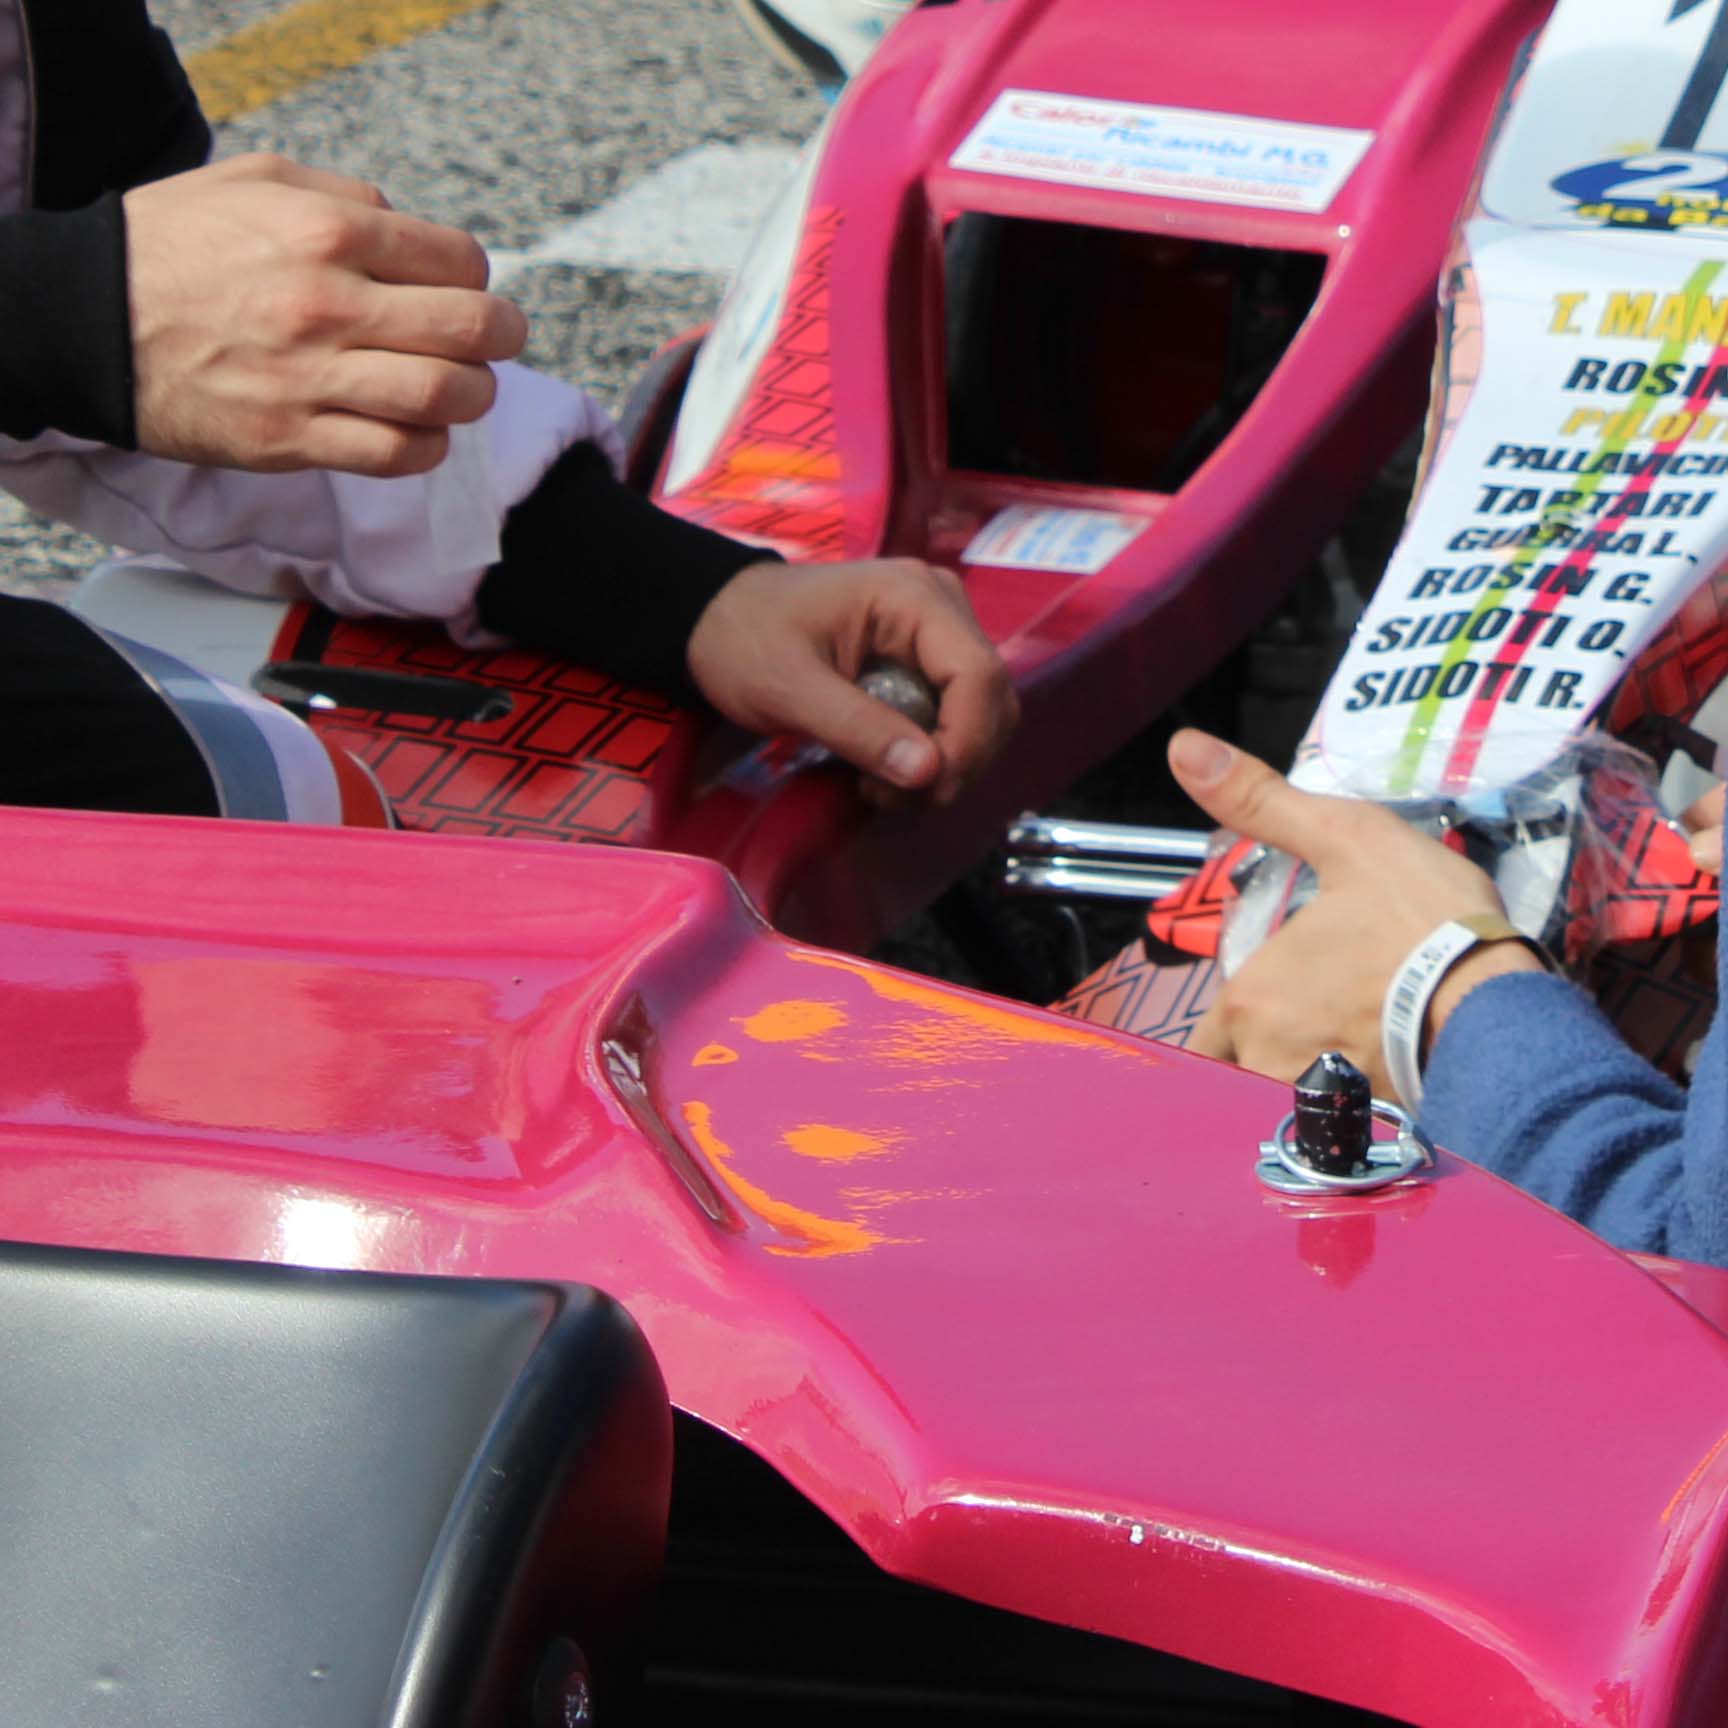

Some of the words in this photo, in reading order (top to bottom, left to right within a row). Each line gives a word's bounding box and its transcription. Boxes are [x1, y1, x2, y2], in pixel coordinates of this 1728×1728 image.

[1576, 202, 1649, 223] da
[1474, 483, 1717, 517] TARTARI
[1406, 561, 1599, 600] ROSIN
[1602, 571, 1654, 605] G.
[1366, 607, 1573, 653] SIDOTI
[1576, 618, 1627, 658] O.
[1343, 660, 1535, 712] SIDOTI
[1535, 669, 1586, 710] R.
